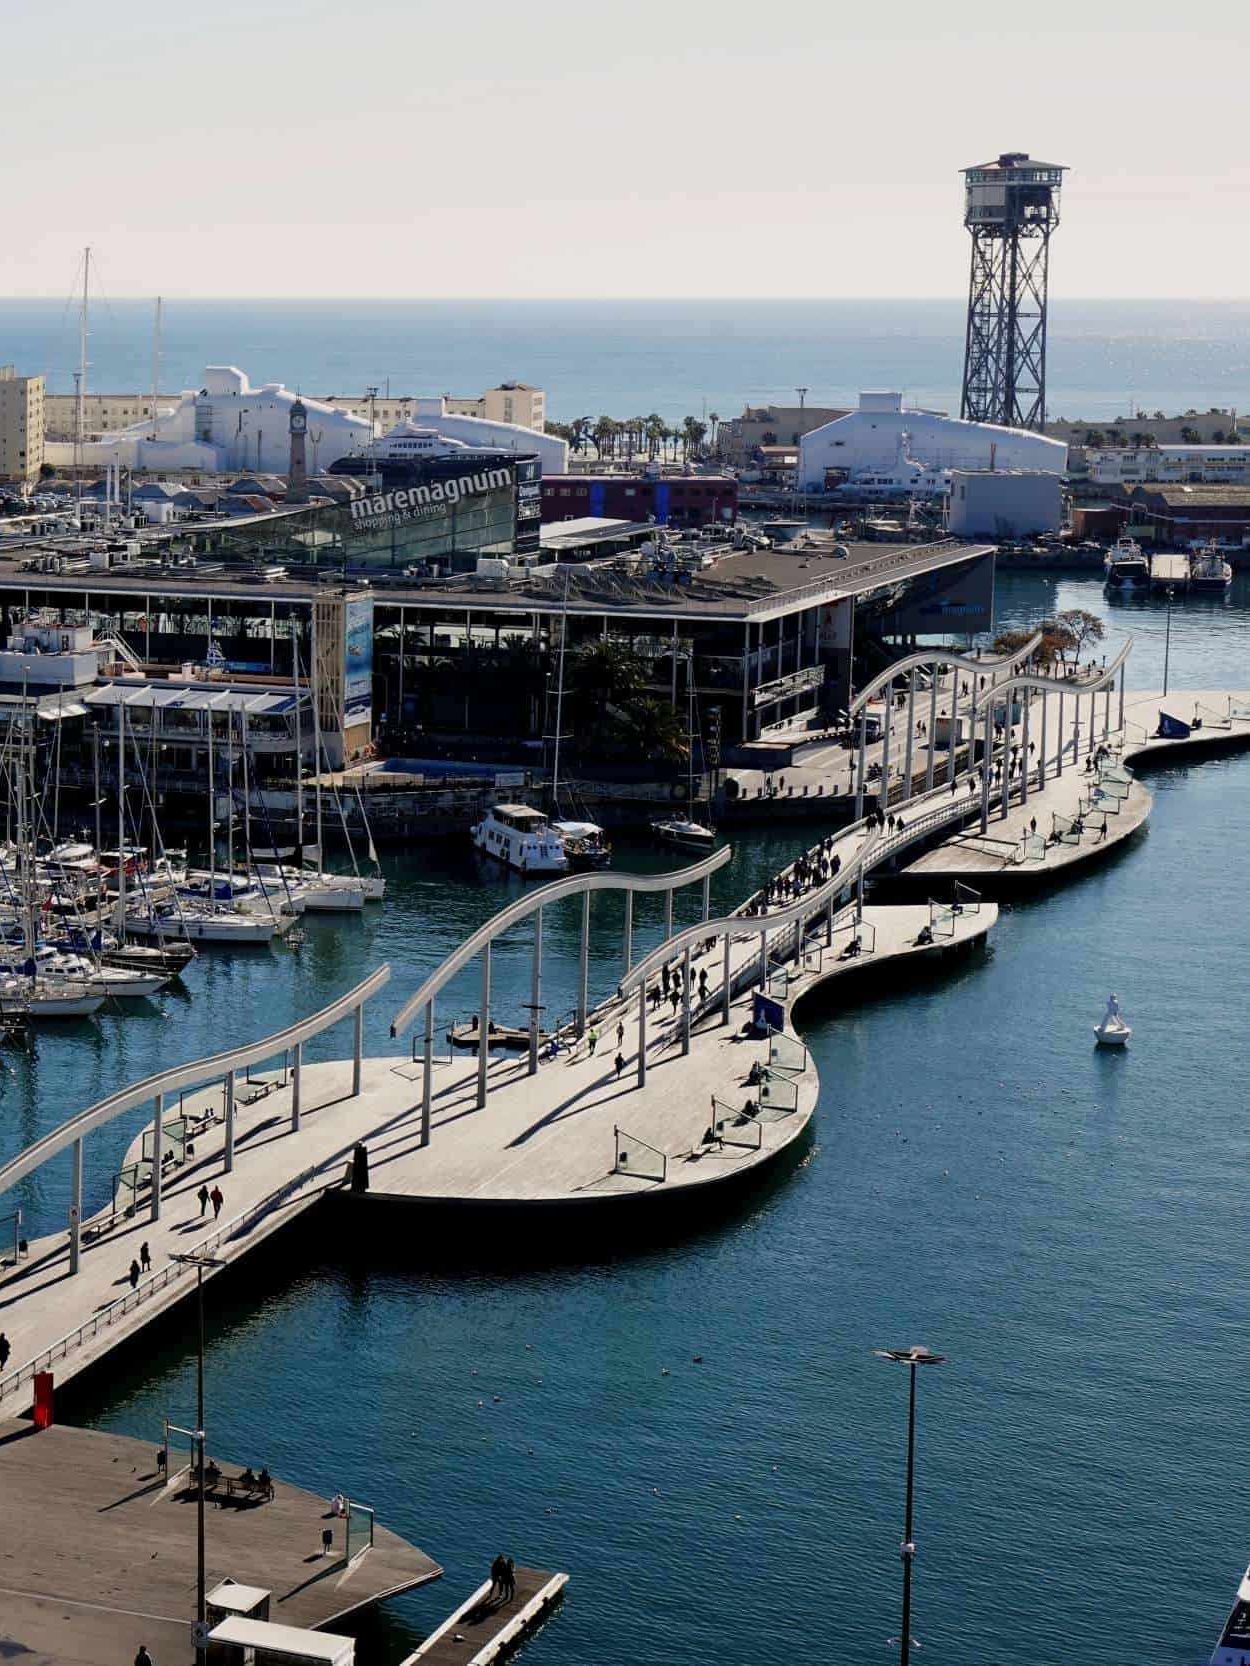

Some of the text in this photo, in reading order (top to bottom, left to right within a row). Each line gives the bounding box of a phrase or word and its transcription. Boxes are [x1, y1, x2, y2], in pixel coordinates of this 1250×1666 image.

[350, 468, 512, 518] maremagnum
[354, 503, 447, 530] shopping & dining
